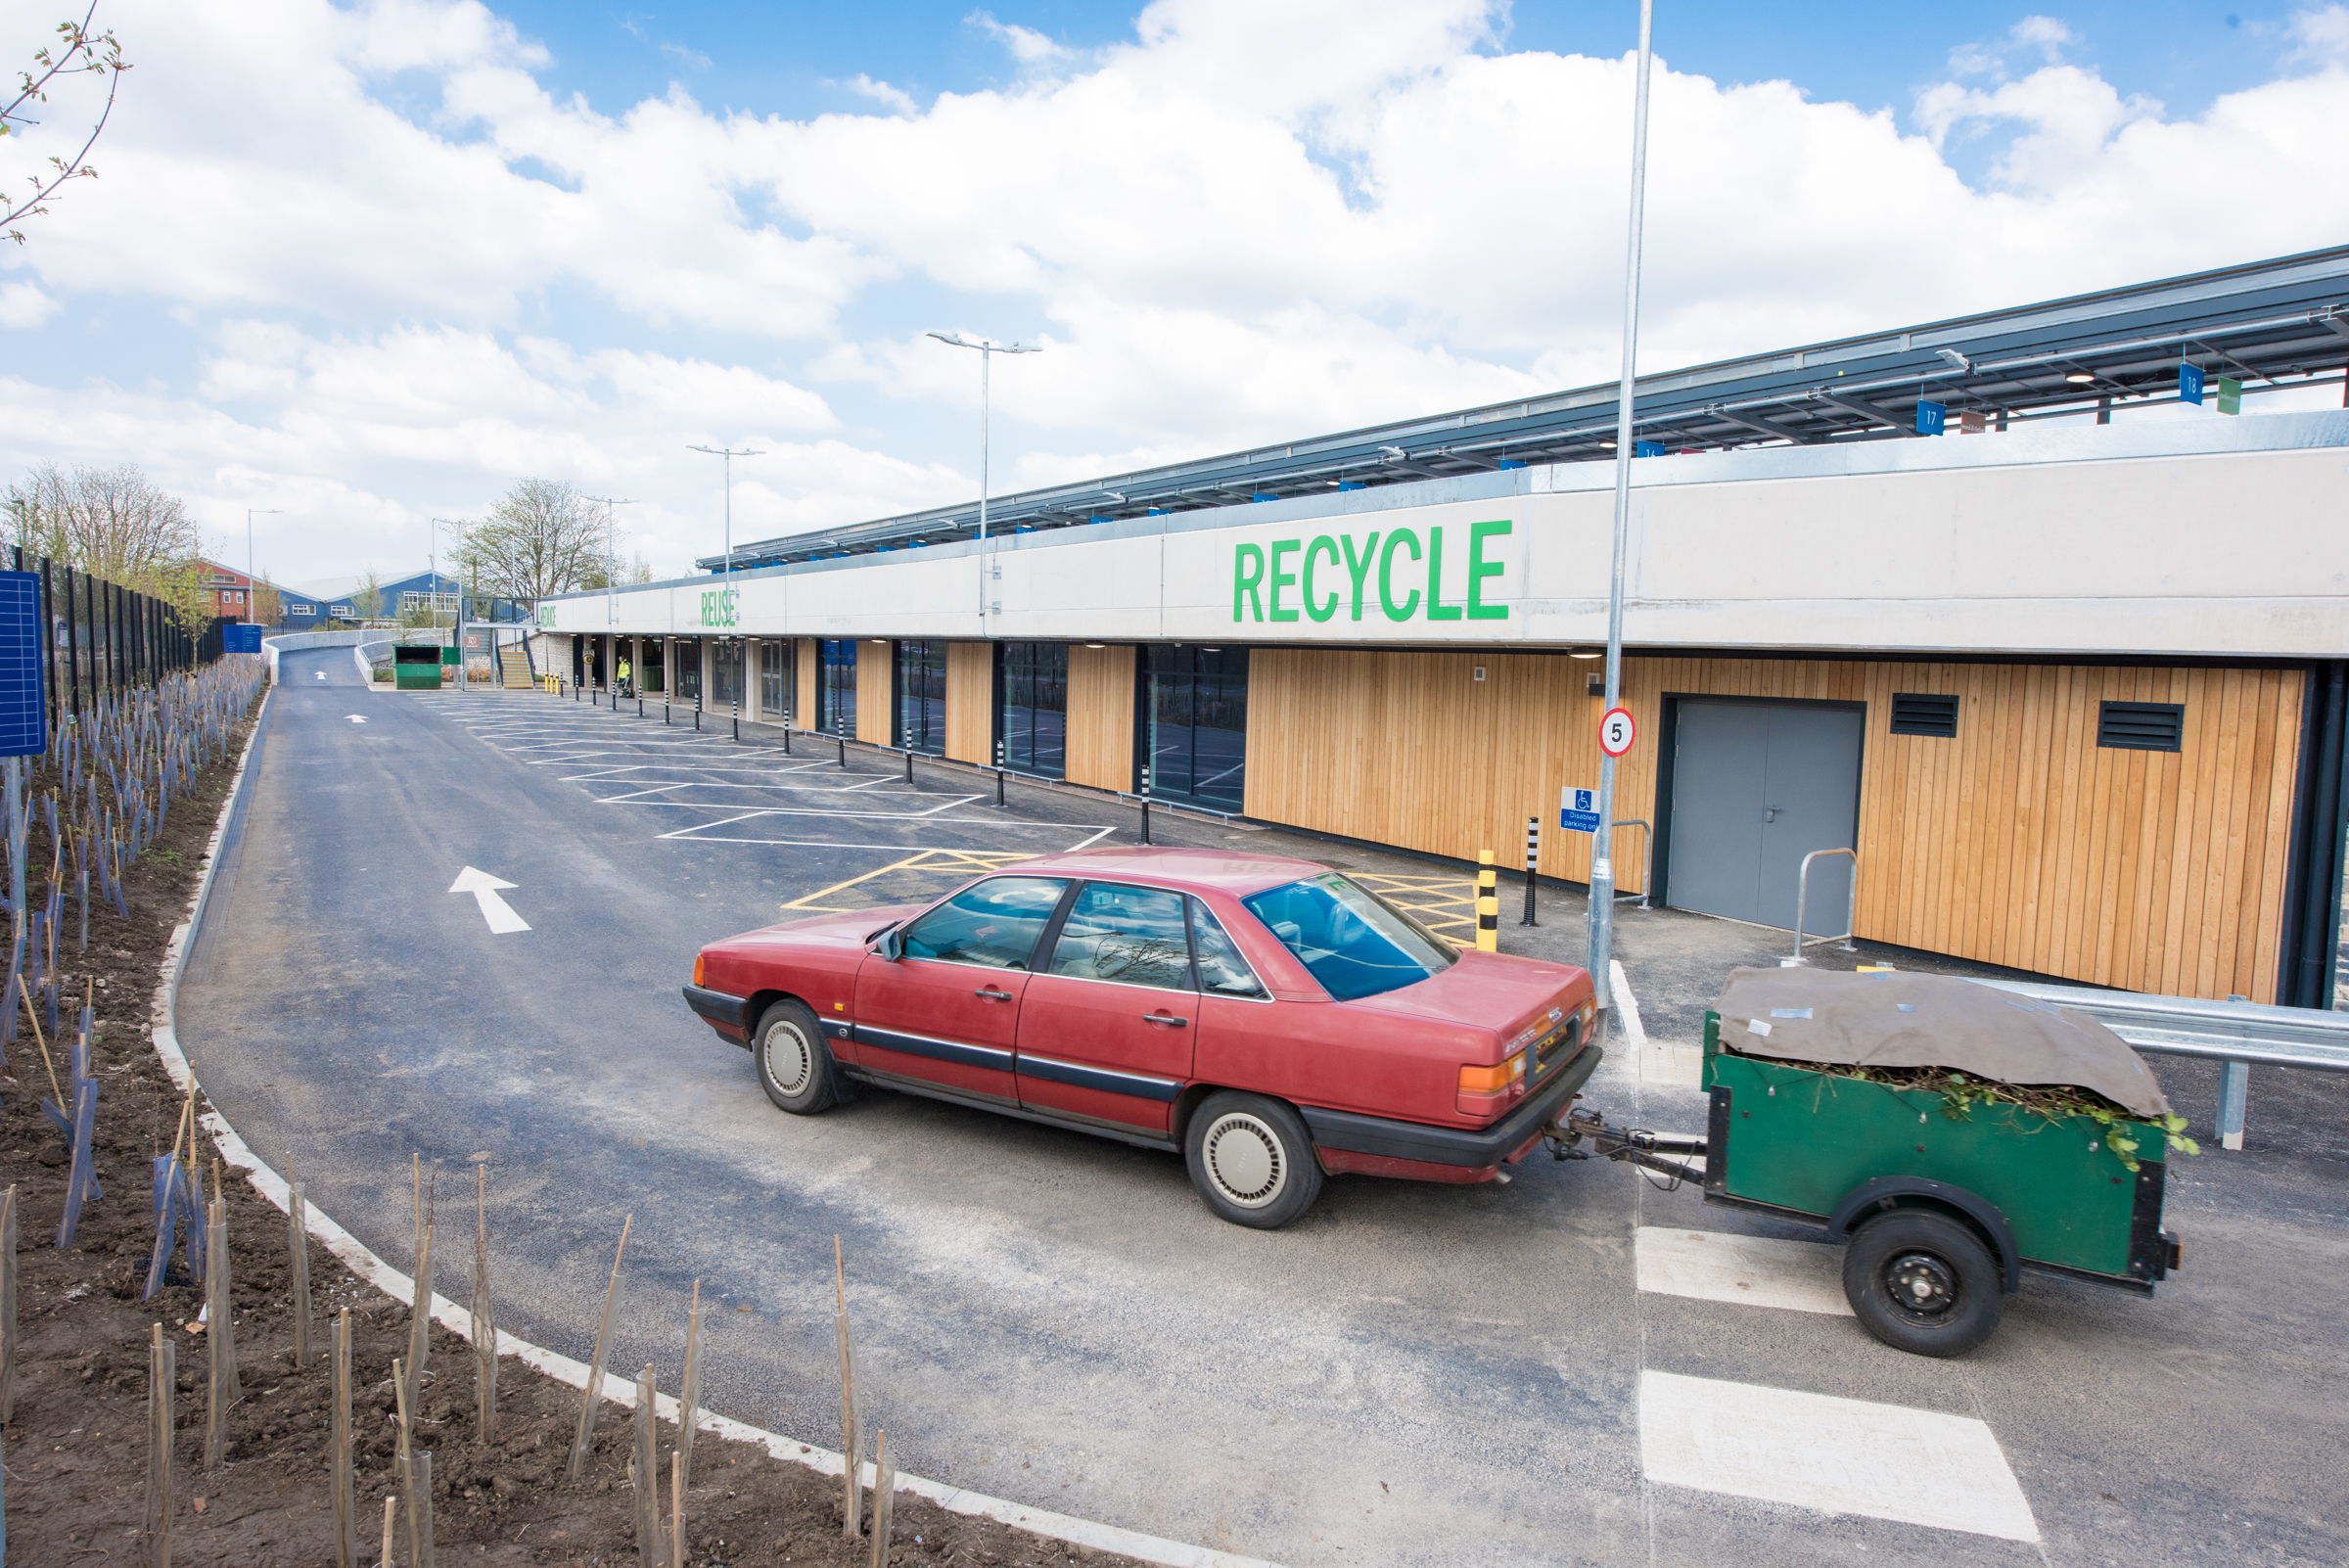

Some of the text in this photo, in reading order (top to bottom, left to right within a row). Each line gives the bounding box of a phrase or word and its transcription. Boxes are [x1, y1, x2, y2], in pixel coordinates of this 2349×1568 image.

[2188, 376, 2196, 393] 18
[1926, 410, 1937, 426] 17
[1233, 520, 1512, 623] RECYCLE
[701, 589, 735, 627] REUSE
[1611, 723, 1623, 743] 5
[1564, 820, 1587, 830] parking
[1569, 811, 1596, 822] Disabled
